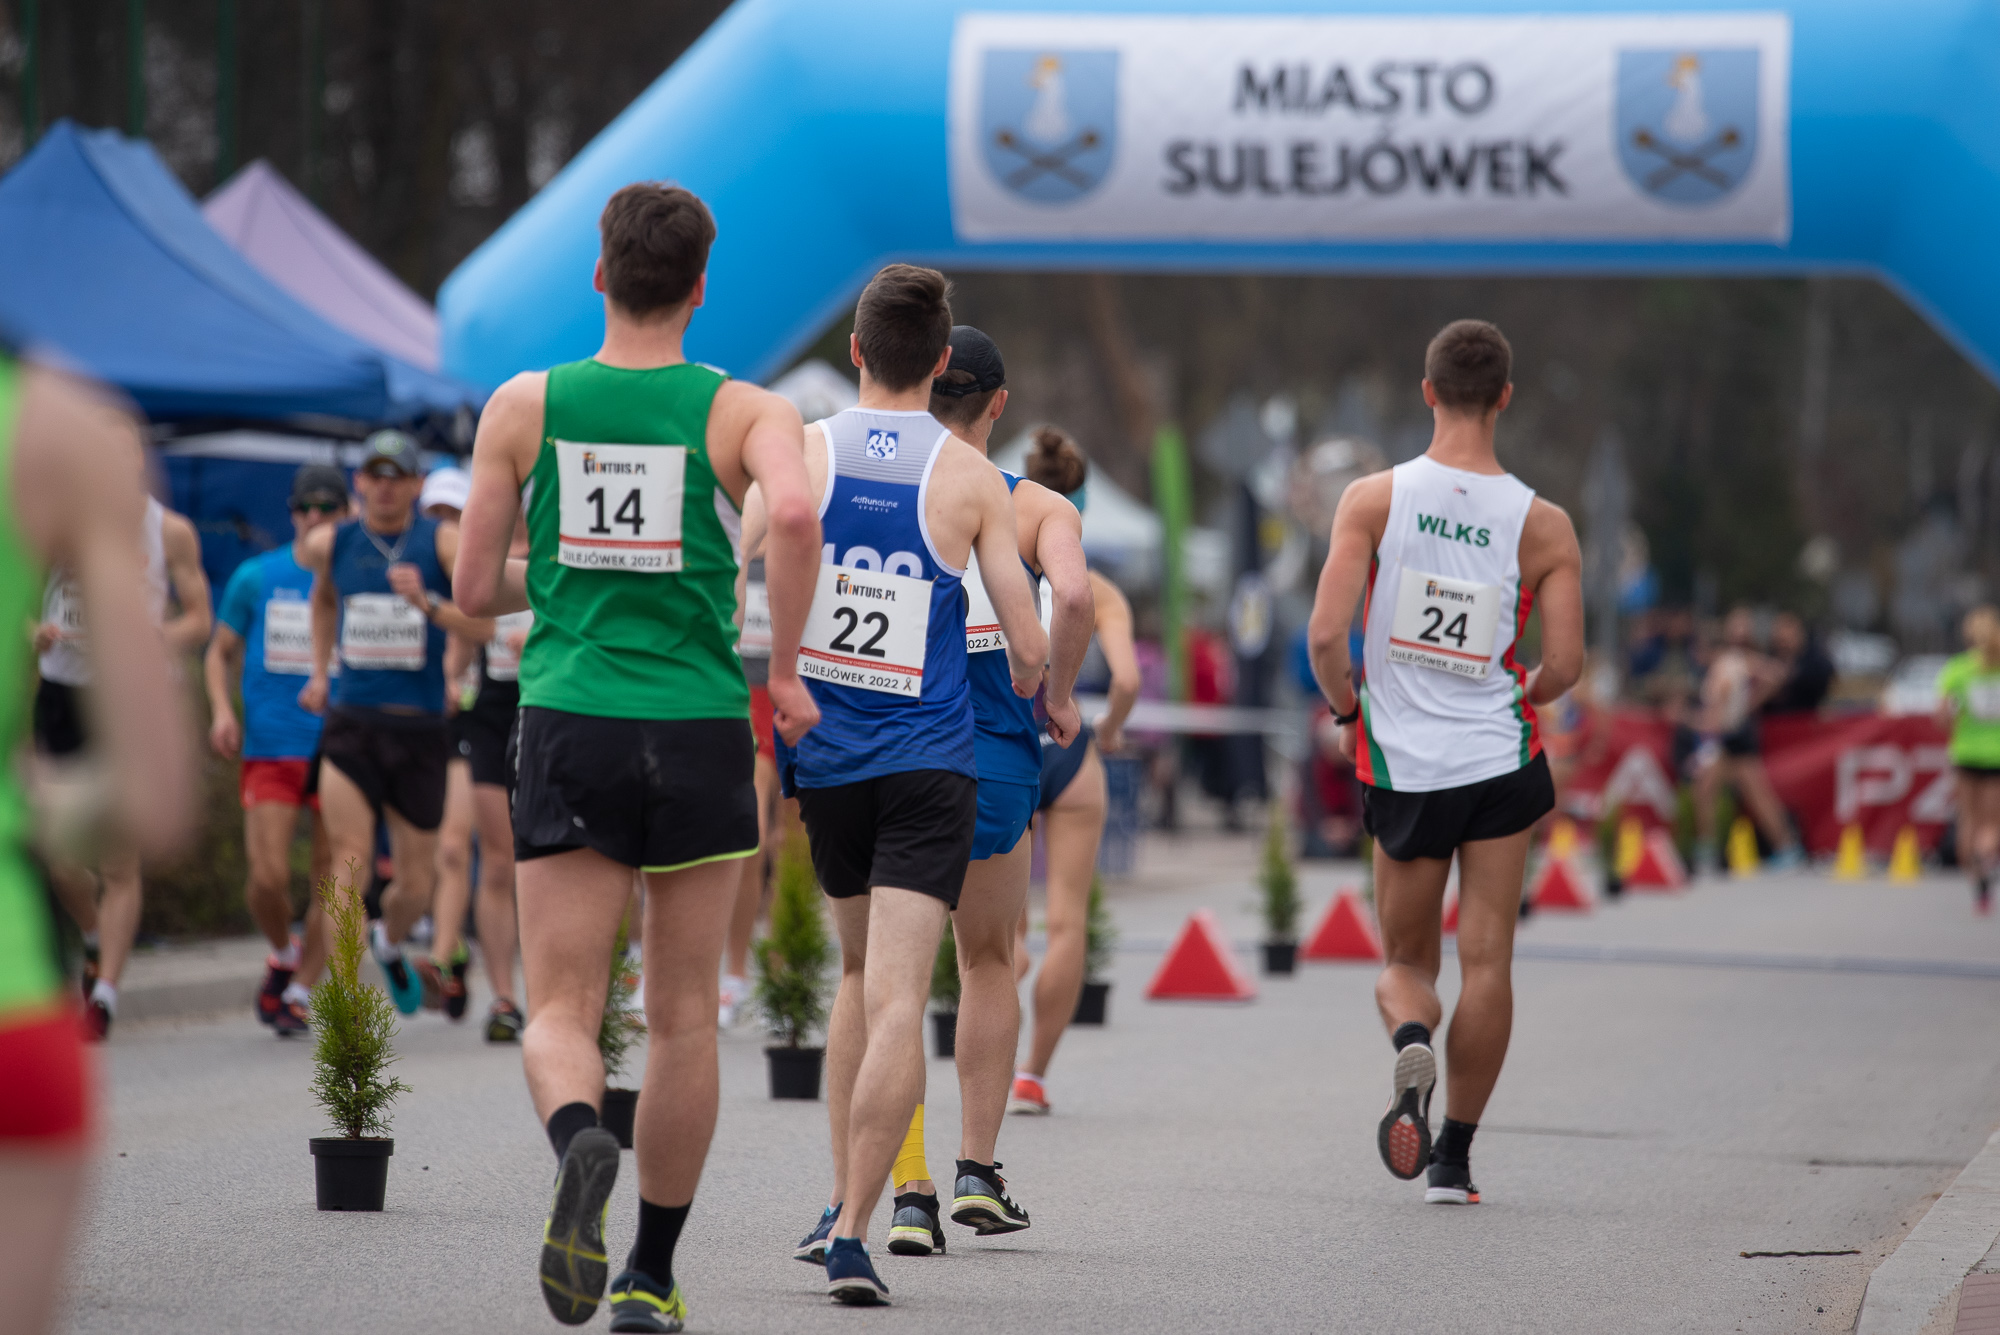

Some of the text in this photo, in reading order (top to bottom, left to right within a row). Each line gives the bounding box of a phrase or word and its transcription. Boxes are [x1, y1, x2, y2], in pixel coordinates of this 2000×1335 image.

[1234, 60, 1497, 115] MIASTO
[1163, 124, 1568, 197] SULEJÓWEK
[586, 486, 645, 536] 14
[1417, 512, 1491, 547] WLKS
[563, 549, 662, 567] SULEJÓWEK 2022
[829, 606, 890, 658] 22
[967, 638, 989, 649] 022
[1418, 606, 1468, 649] 24
[803, 662, 899, 689] SULEJÓWEK 2022
[1390, 649, 1448, 669] SULEJÓWEK
[1451, 663, 1476, 675] 2022
